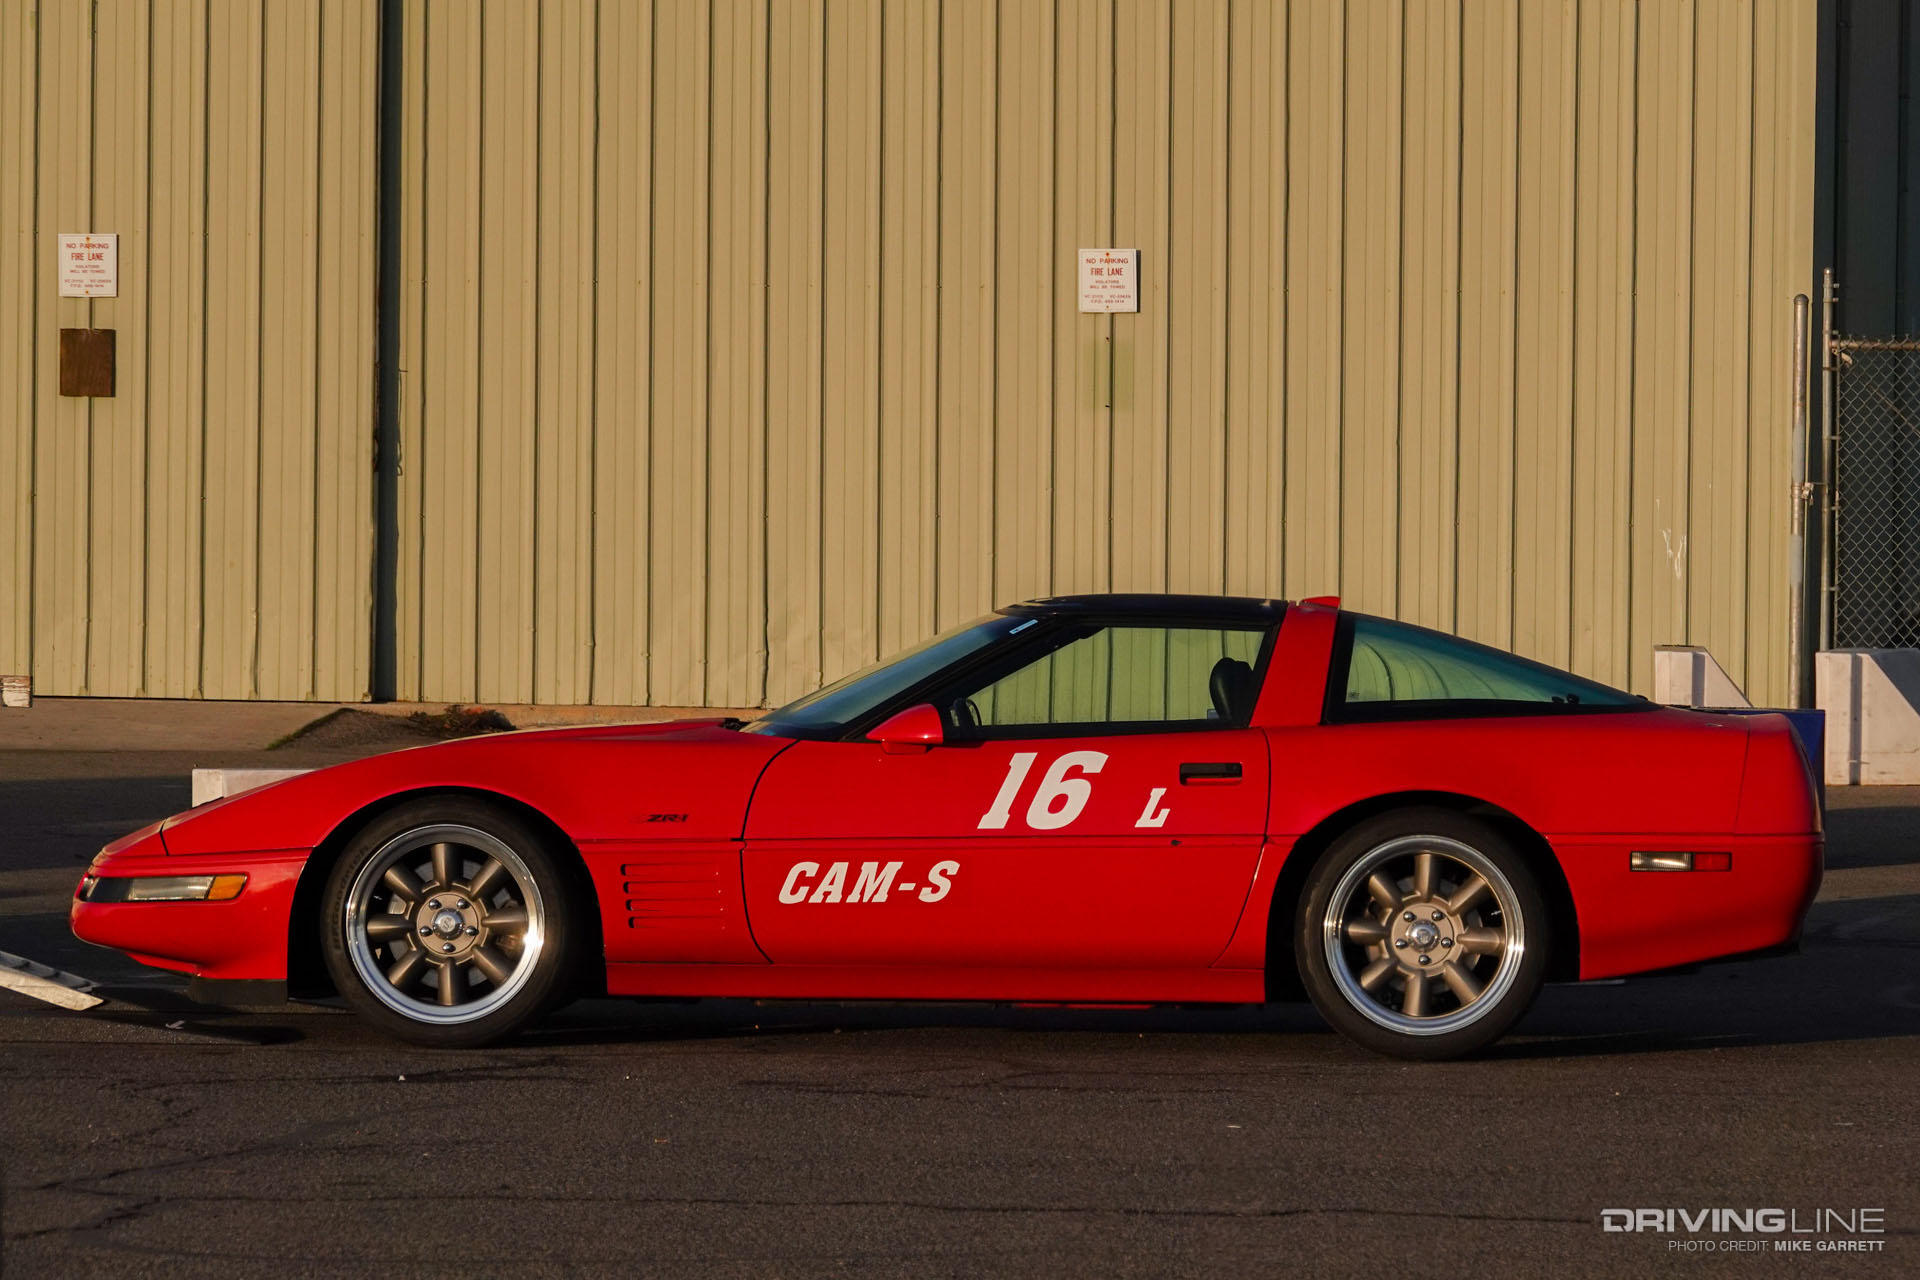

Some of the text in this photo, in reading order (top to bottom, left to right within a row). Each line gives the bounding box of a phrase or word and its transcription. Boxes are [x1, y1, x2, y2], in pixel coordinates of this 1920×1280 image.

[71, 252, 105, 261] FIRE LANE
[1091, 267, 1123, 276] FIRE LANE
[977, 750, 1171, 830] 16 L
[778, 860, 961, 904] CAM-S
